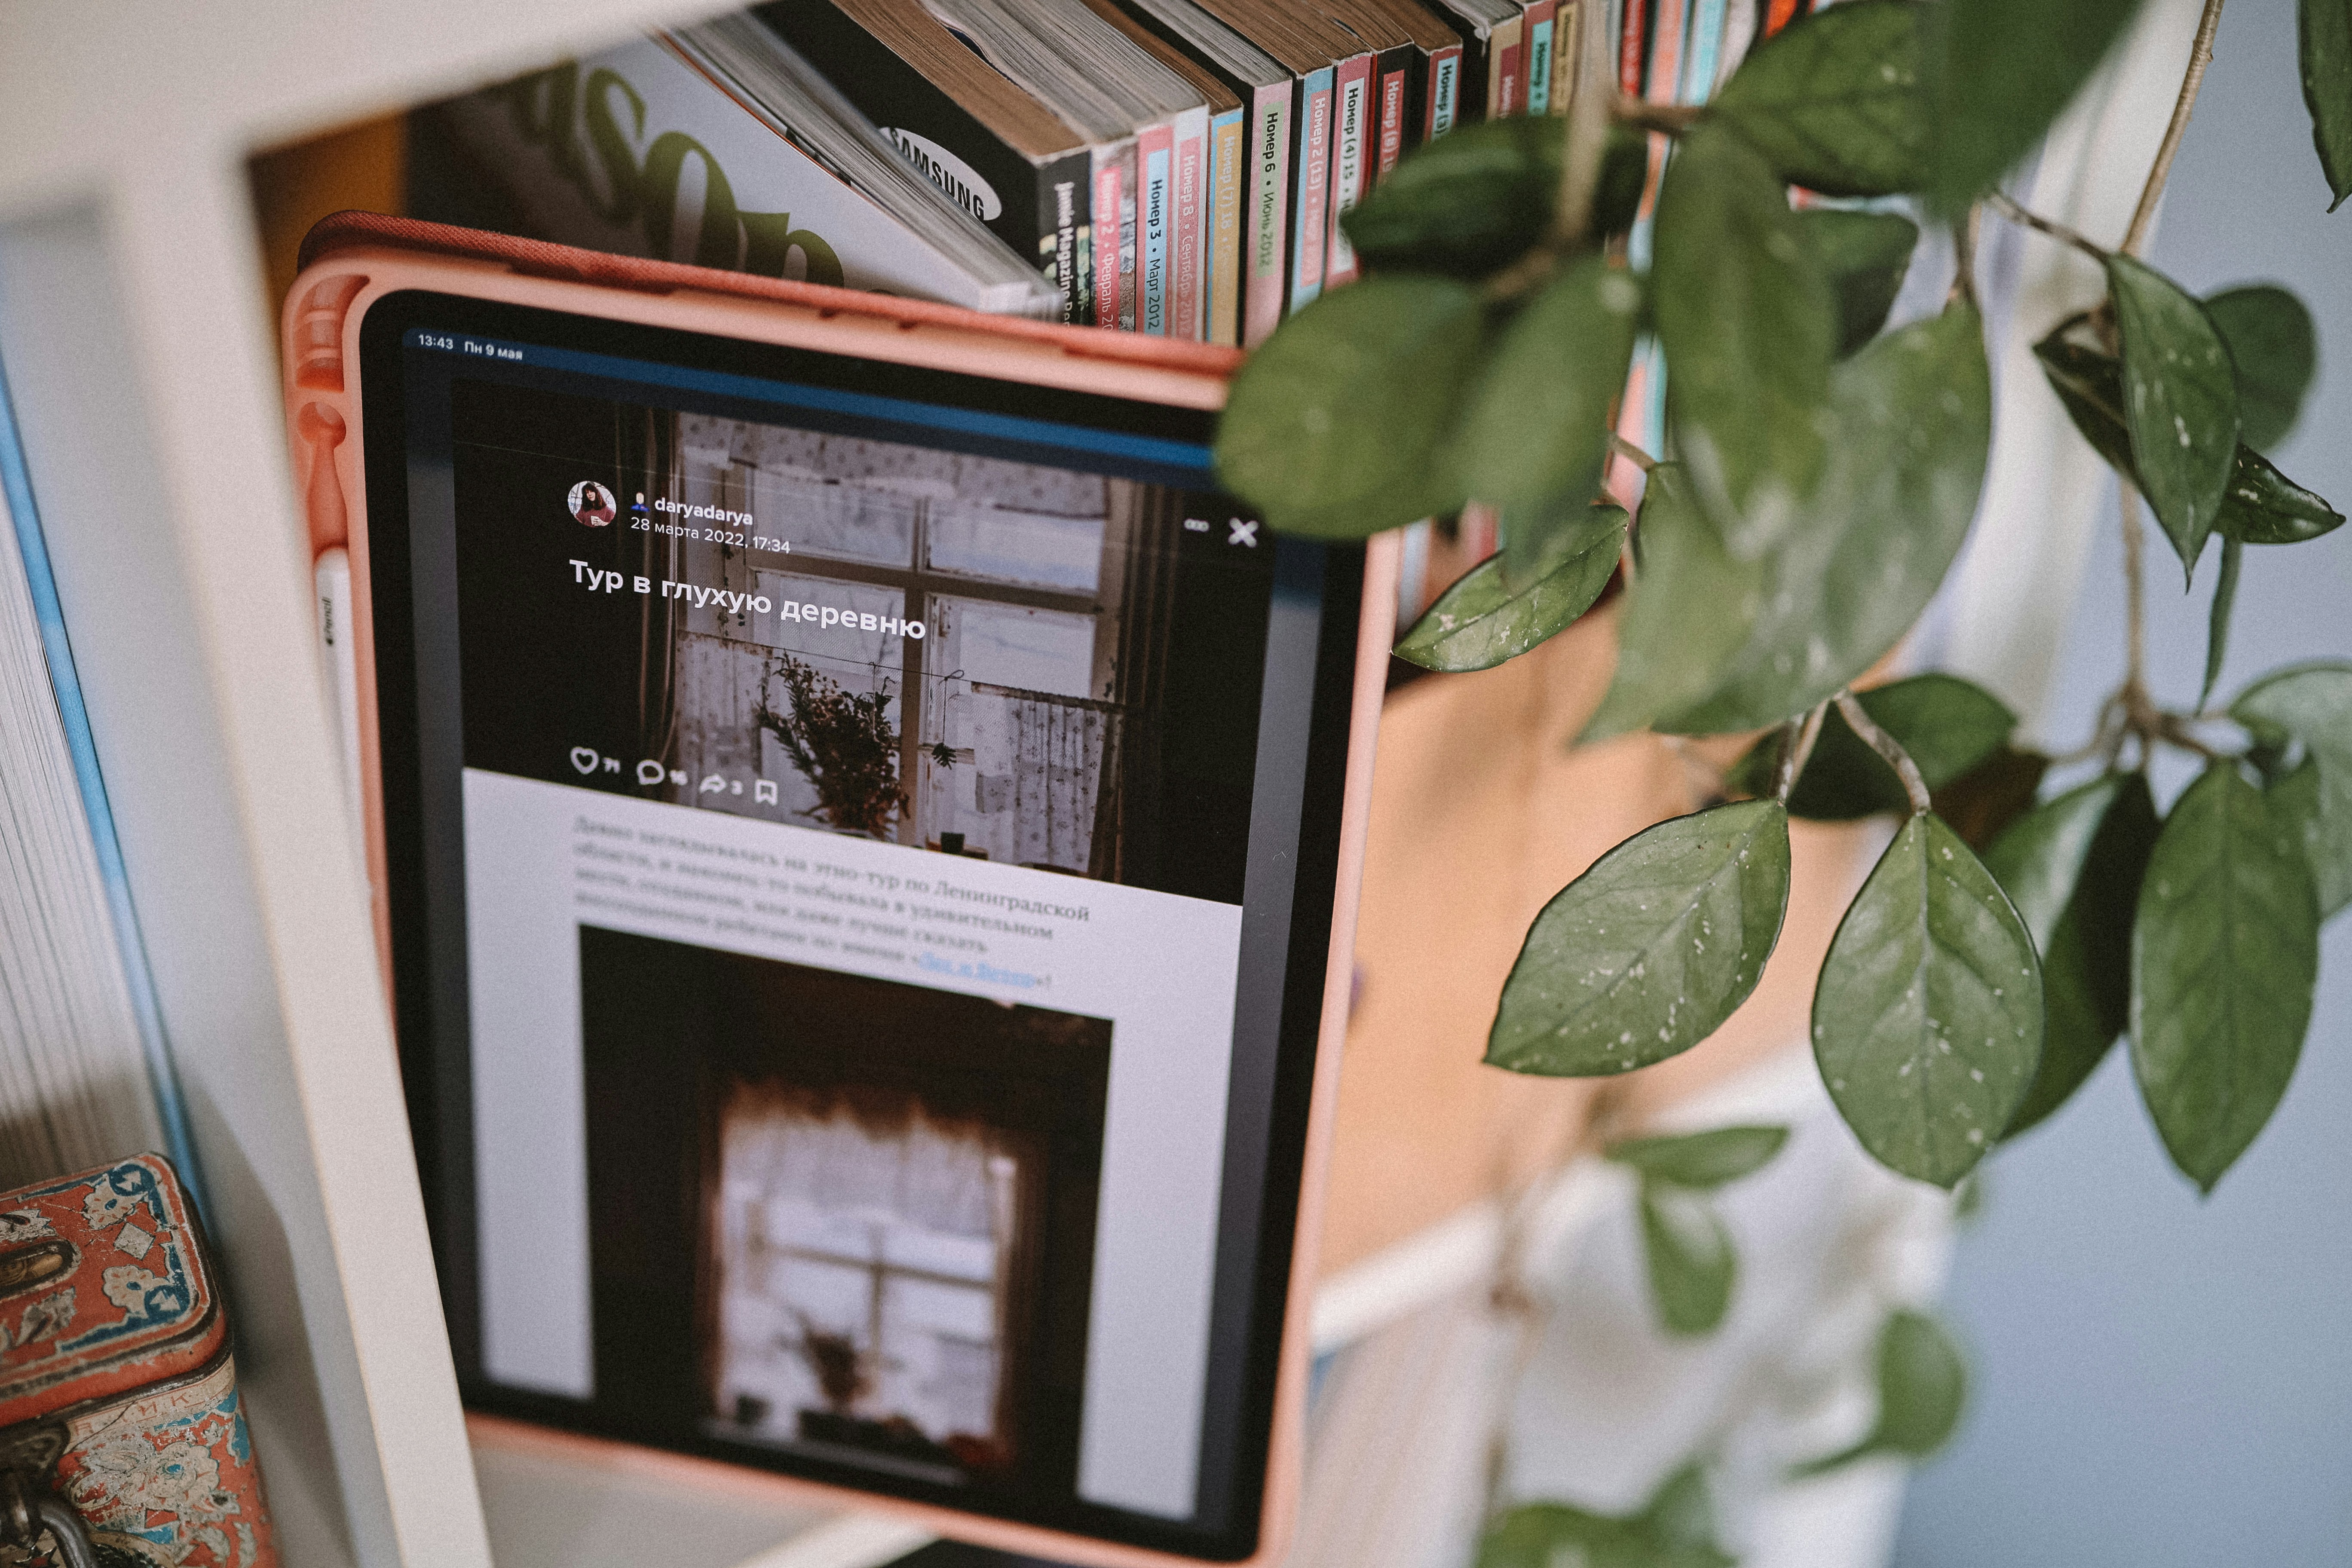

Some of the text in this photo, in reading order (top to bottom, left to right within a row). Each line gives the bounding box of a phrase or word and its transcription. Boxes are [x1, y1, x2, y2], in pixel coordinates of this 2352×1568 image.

[1344, 88, 1358, 135] Номер
[1384, 81, 1400, 128] Номер
[1221, 136, 1235, 183] Номер
[1262, 112, 1278, 160] Номер
[1309, 98, 1326, 189] Номер 2 (13)
[1344, 138, 1356, 159] (4)
[888, 128, 984, 221] SAMSUNG
[1180, 155, 1195, 202] Номер
[1265, 163, 1275, 172] 6
[1101, 226, 1115, 234] 2
[1183, 206, 1194, 217] 8
[1262, 192, 1274, 230] Июнь
[1147, 179, 1162, 330] Номер 3 Март 2012
[1180, 236, 1193, 297] Сентябрь
[1098, 253, 1116, 312] Февраль
[418, 334, 523, 360] 13:43 Пн 9 мая
[654, 497, 753, 526] daryadarya
[631, 517, 790, 554] 28 марта 2022, 17:34
[569, 559, 926, 639] Тур в глухую деревню
[911, 904, 1053, 940] удивительном
[934, 880, 1090, 921] Ленинградской
